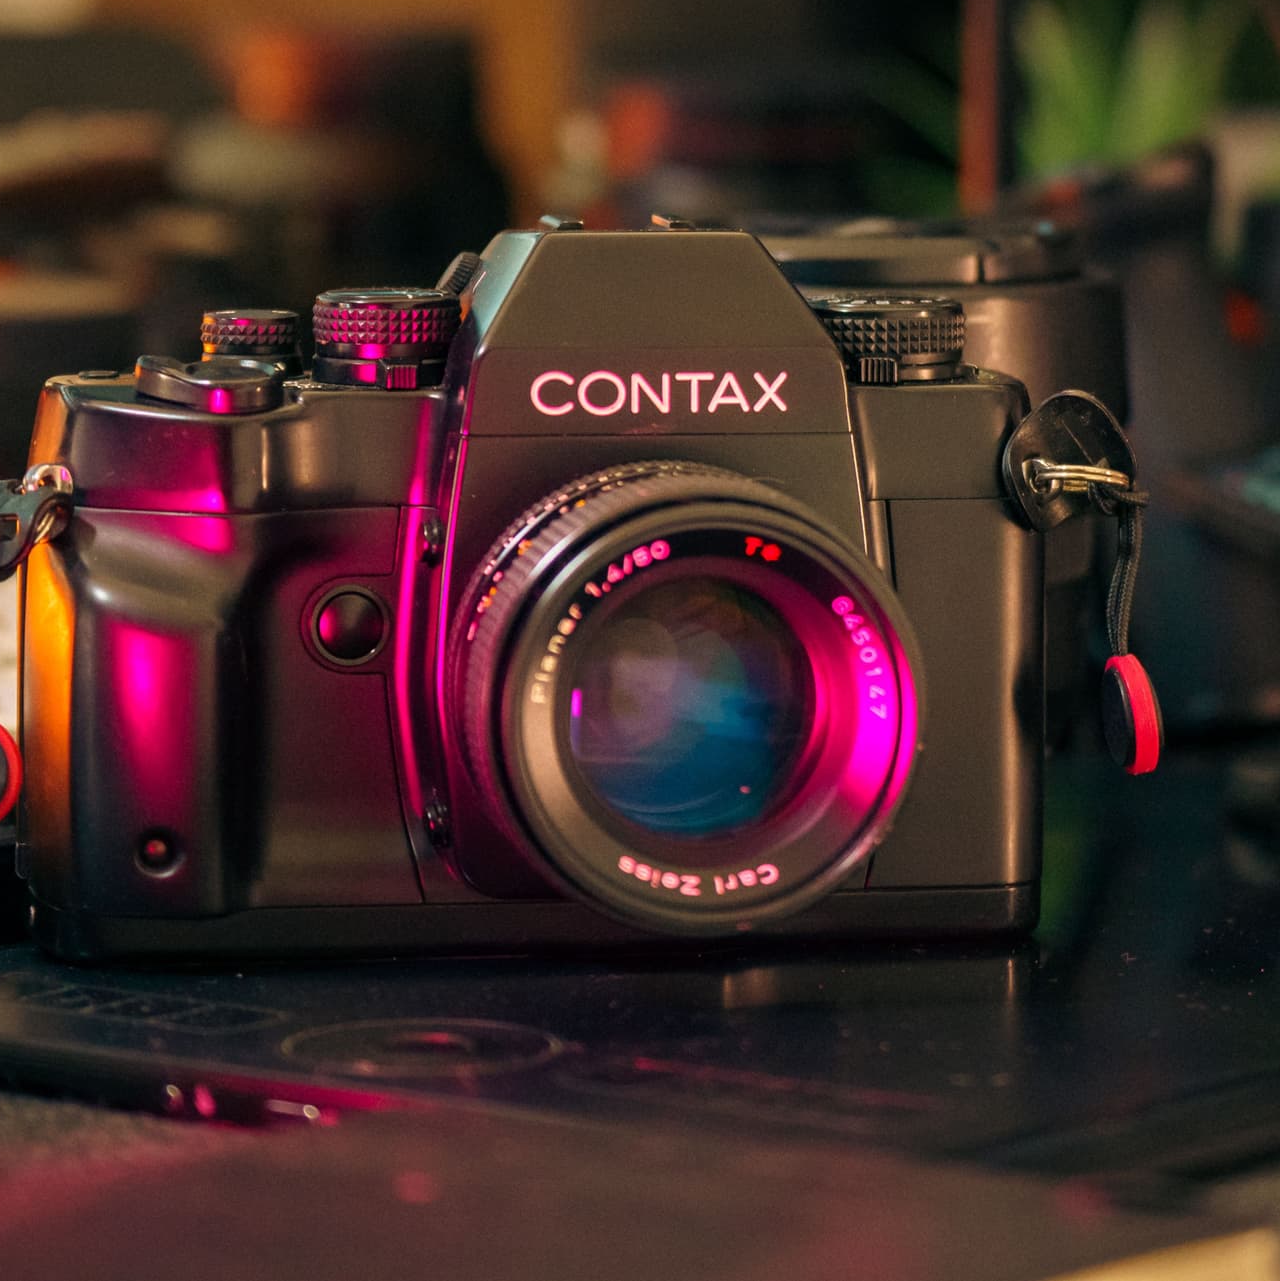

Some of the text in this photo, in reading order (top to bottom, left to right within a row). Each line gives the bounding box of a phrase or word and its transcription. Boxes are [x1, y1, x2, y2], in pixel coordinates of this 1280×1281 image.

[530, 370, 788, 416] CONTAX
[531, 603, 582, 704] Planar
[585, 540, 671, 598] 1.4/50
[618, 855, 779, 896] Carl Zeiss
